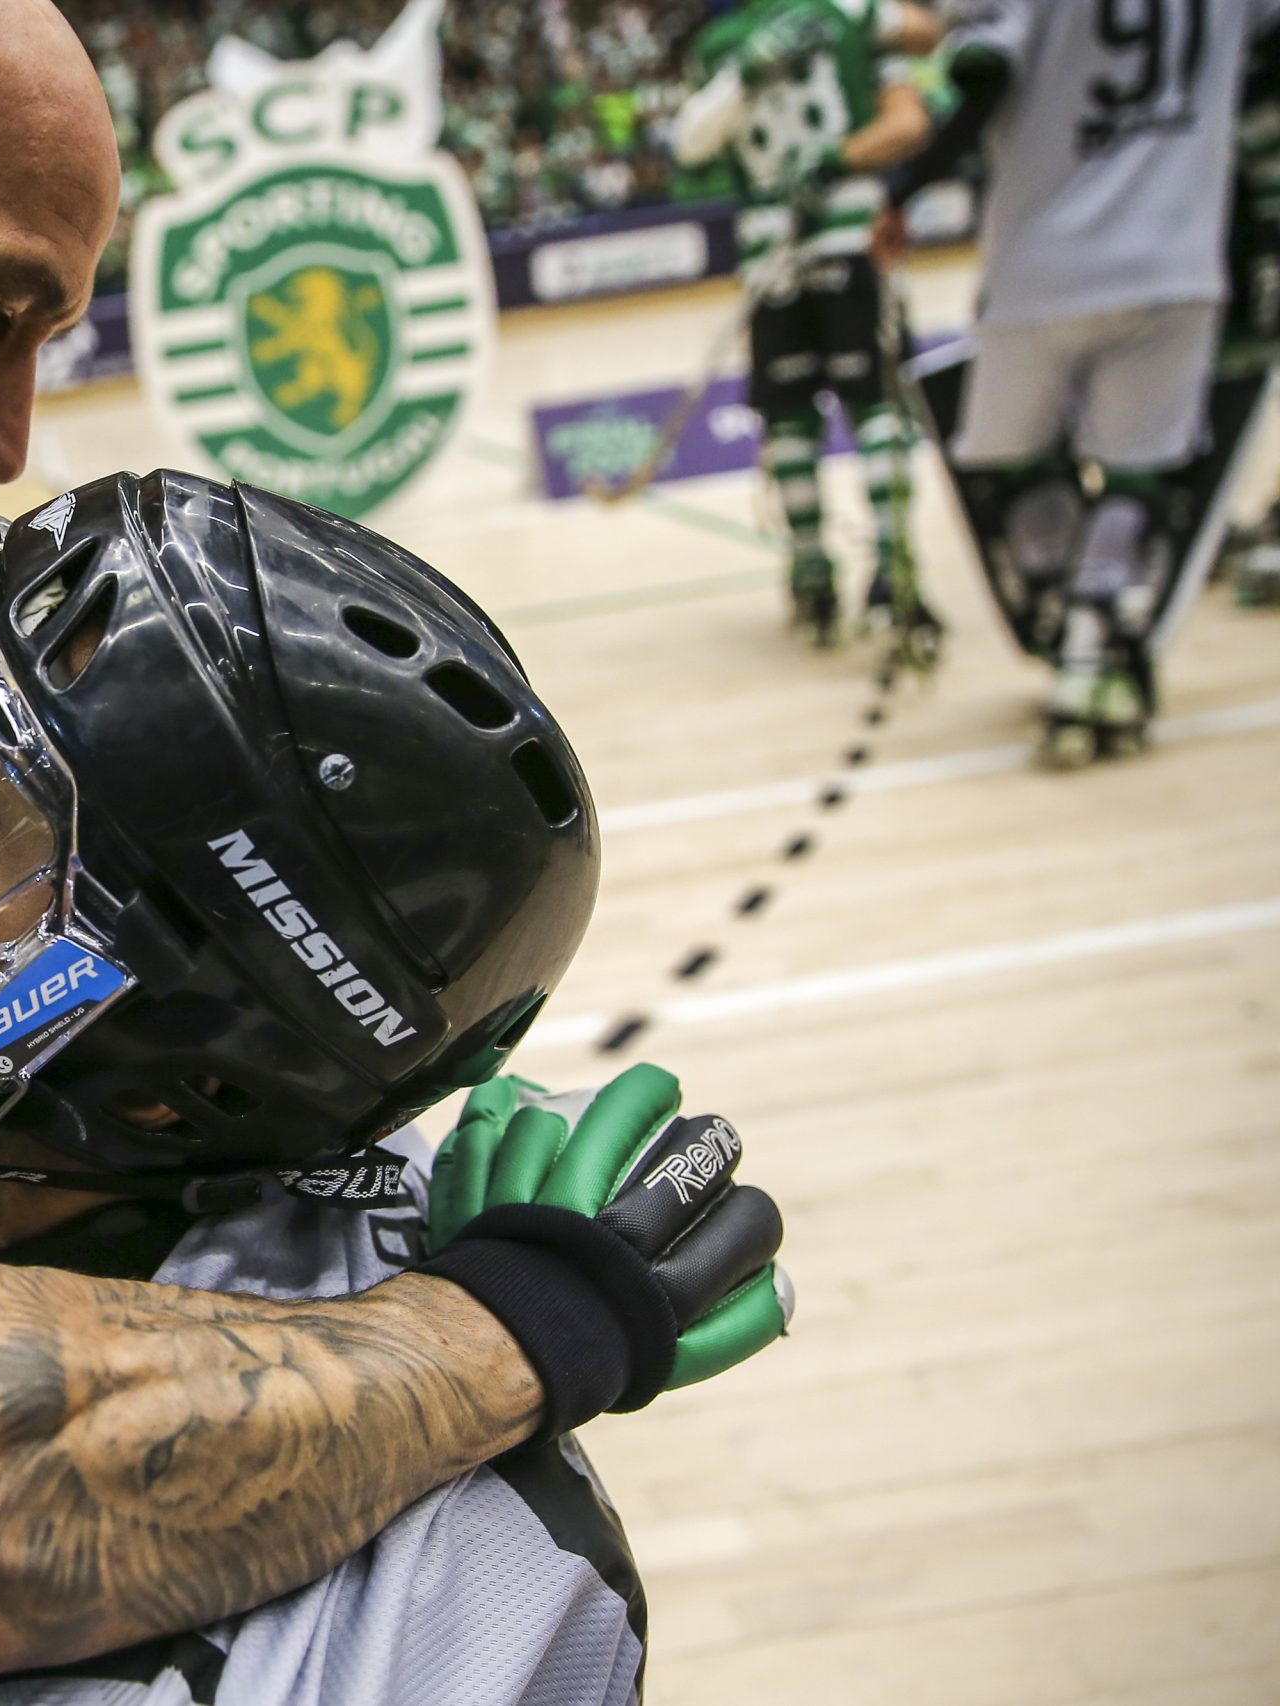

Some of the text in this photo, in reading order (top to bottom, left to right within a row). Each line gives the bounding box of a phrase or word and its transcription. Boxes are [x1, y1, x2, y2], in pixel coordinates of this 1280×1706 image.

[177, 80, 406, 180] SCP
[173, 178, 441, 300] SPORTING
[206, 828, 418, 1048] MISSION
[26, 1031, 50, 1049] HYBRID
[48, 1016, 71, 1034] SHIELD
[642, 1118, 741, 1205] Reno
